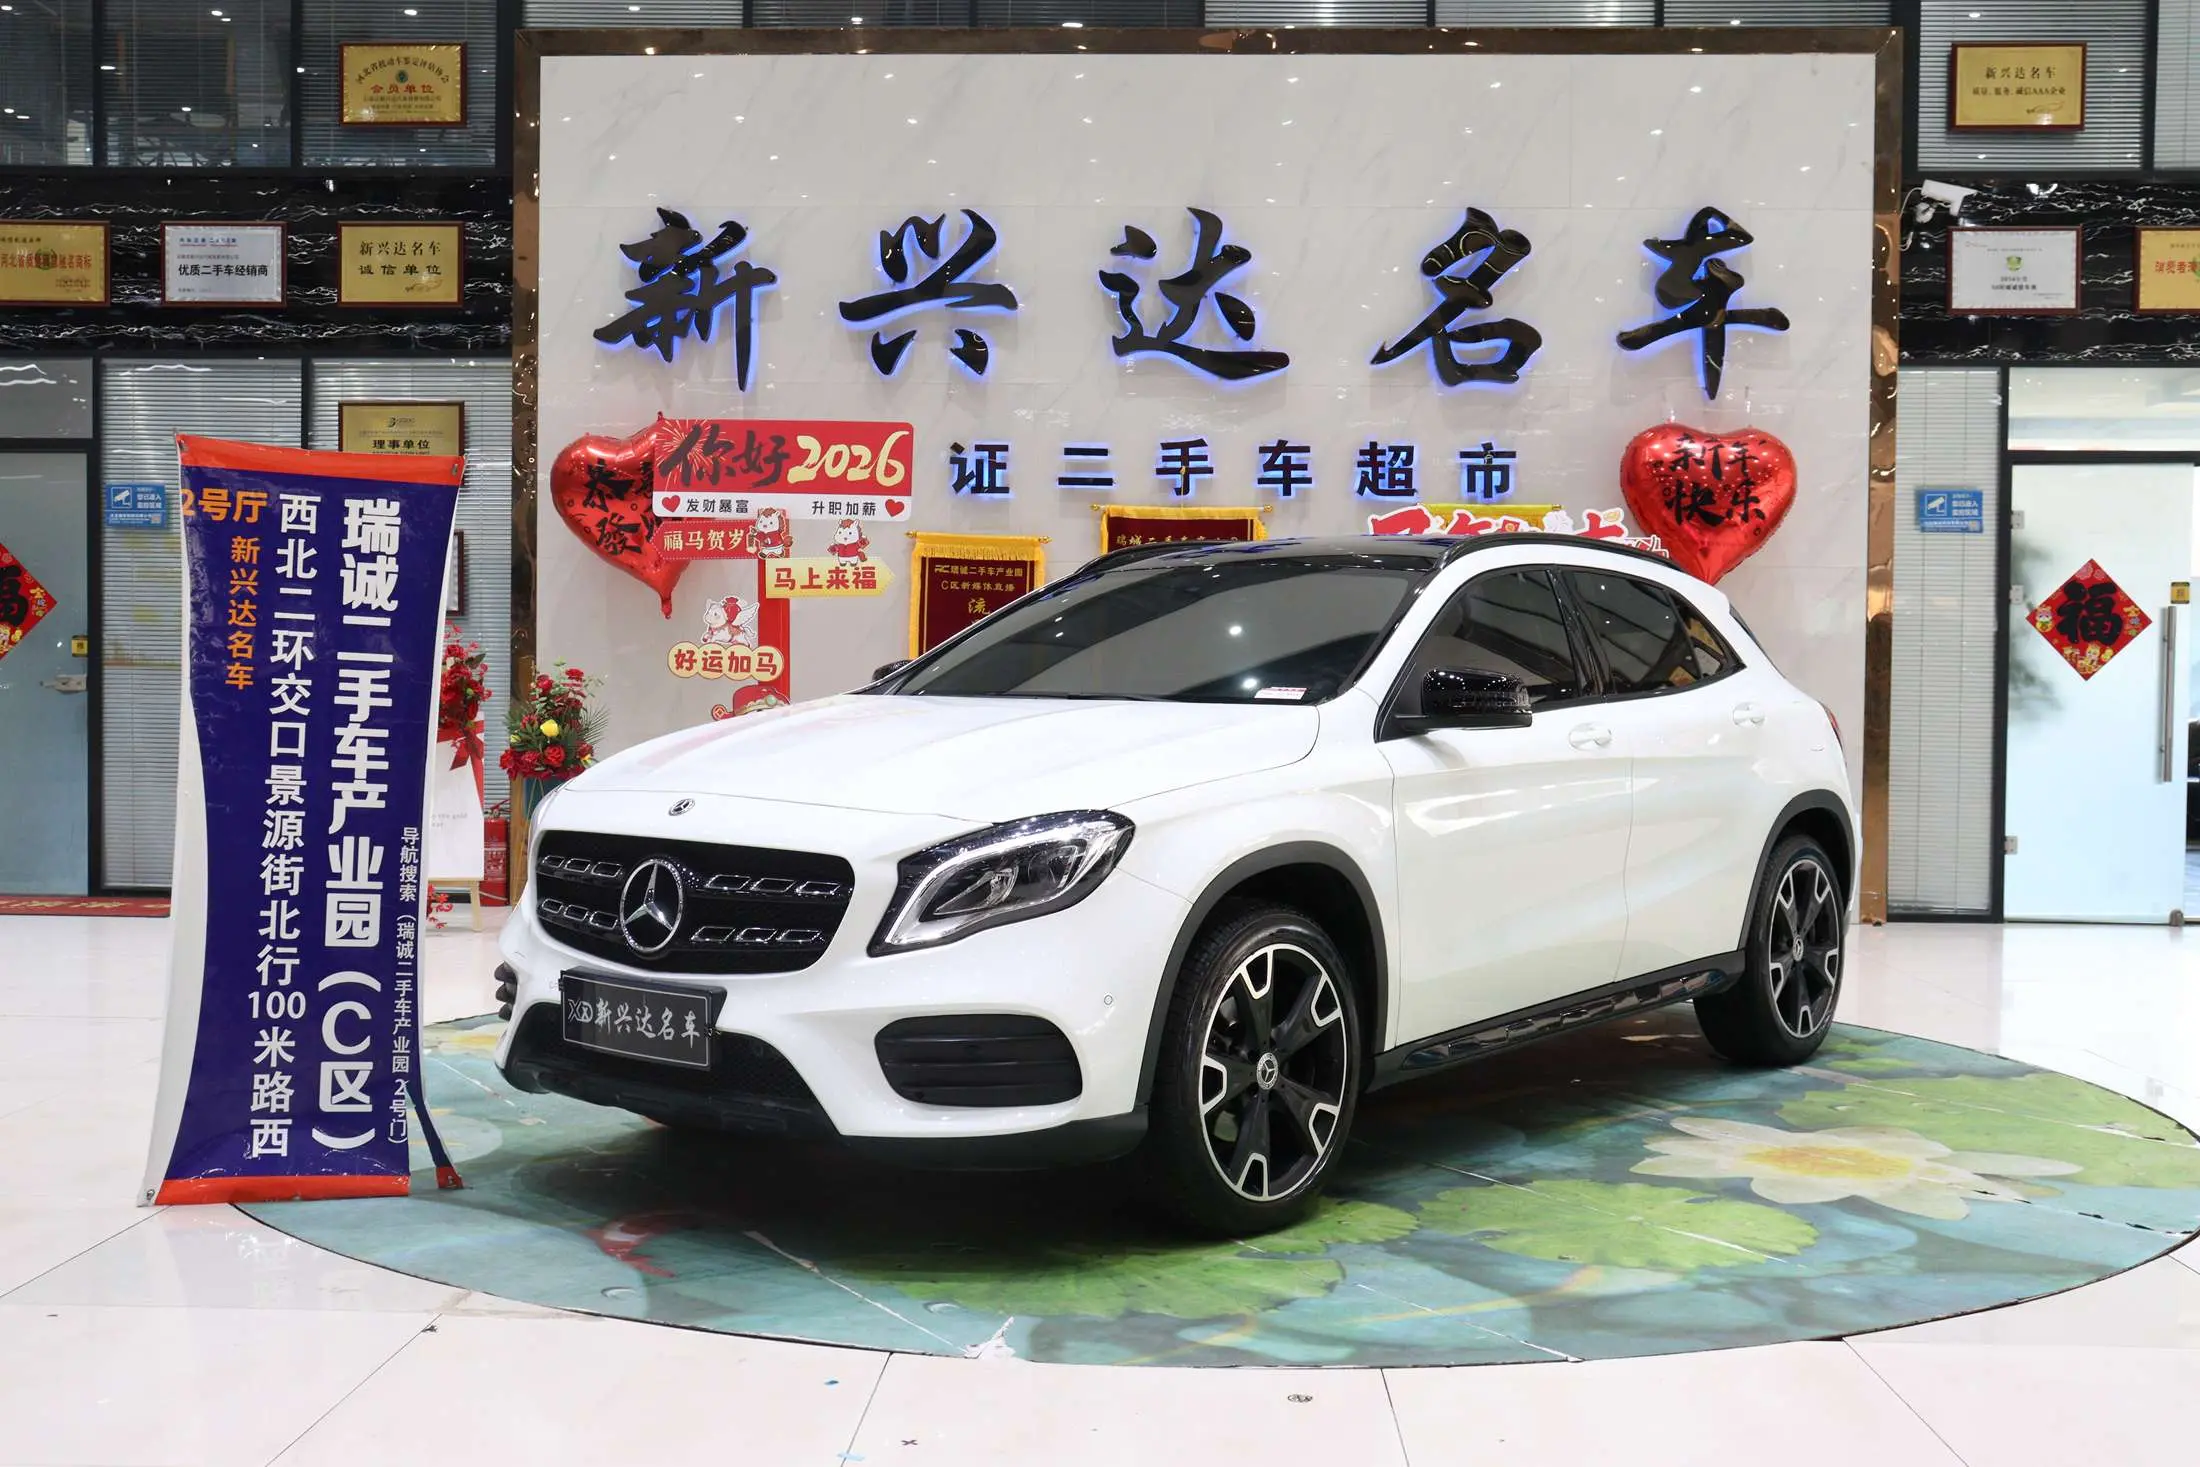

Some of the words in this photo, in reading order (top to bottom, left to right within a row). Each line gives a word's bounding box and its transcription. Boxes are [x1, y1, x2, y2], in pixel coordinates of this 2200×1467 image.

[1985, 66, 2056, 79] 新兴达名车
[370, 84, 434, 94] 会员单位
[360, 240, 441, 256] 新兴达名车
[178, 264, 268, 276] 优质二手车经销商
[358, 264, 442, 275] 诚信单位
[592, 206, 1791, 400] 新兴达名车
[372, 439, 430, 449] 理事单位
[949, 438, 1517, 499] 证二手车超市
[180, 488, 269, 524] 2号厅
[686, 498, 749, 514] 发财暴富
[811, 501, 877, 516] 升职加薪
[664, 529, 746, 552] 福马贺岁
[773, 566, 877, 591] 马上来福
[224, 535, 261, 690] 新兴达名车
[2056, 580, 2124, 646] 福
[673, 649, 778, 676] 好运加马
[249, 493, 322, 1158] 西北二环交口景源街北行100米路西
